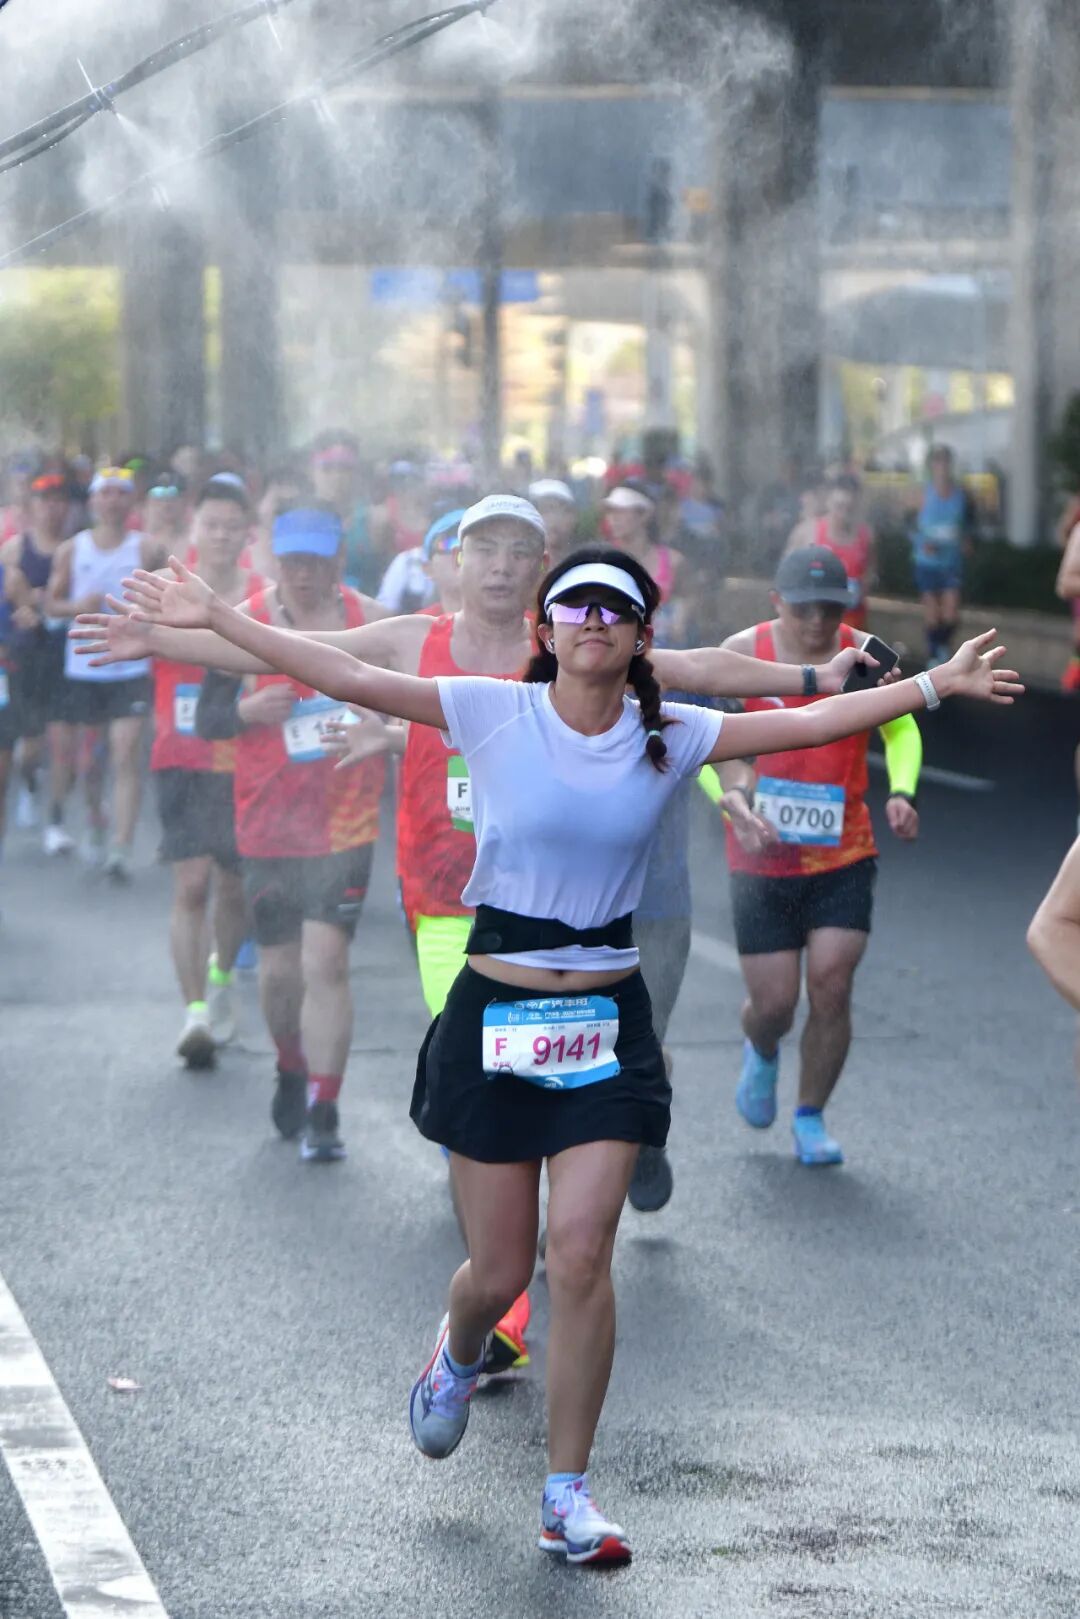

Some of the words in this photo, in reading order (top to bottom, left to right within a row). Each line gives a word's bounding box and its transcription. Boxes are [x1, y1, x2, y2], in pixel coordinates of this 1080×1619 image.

[457, 782, 468, 798] F
[779, 804, 836, 829] 0700
[495, 1037, 508, 1056] F
[533, 1032, 601, 1065] 9141
